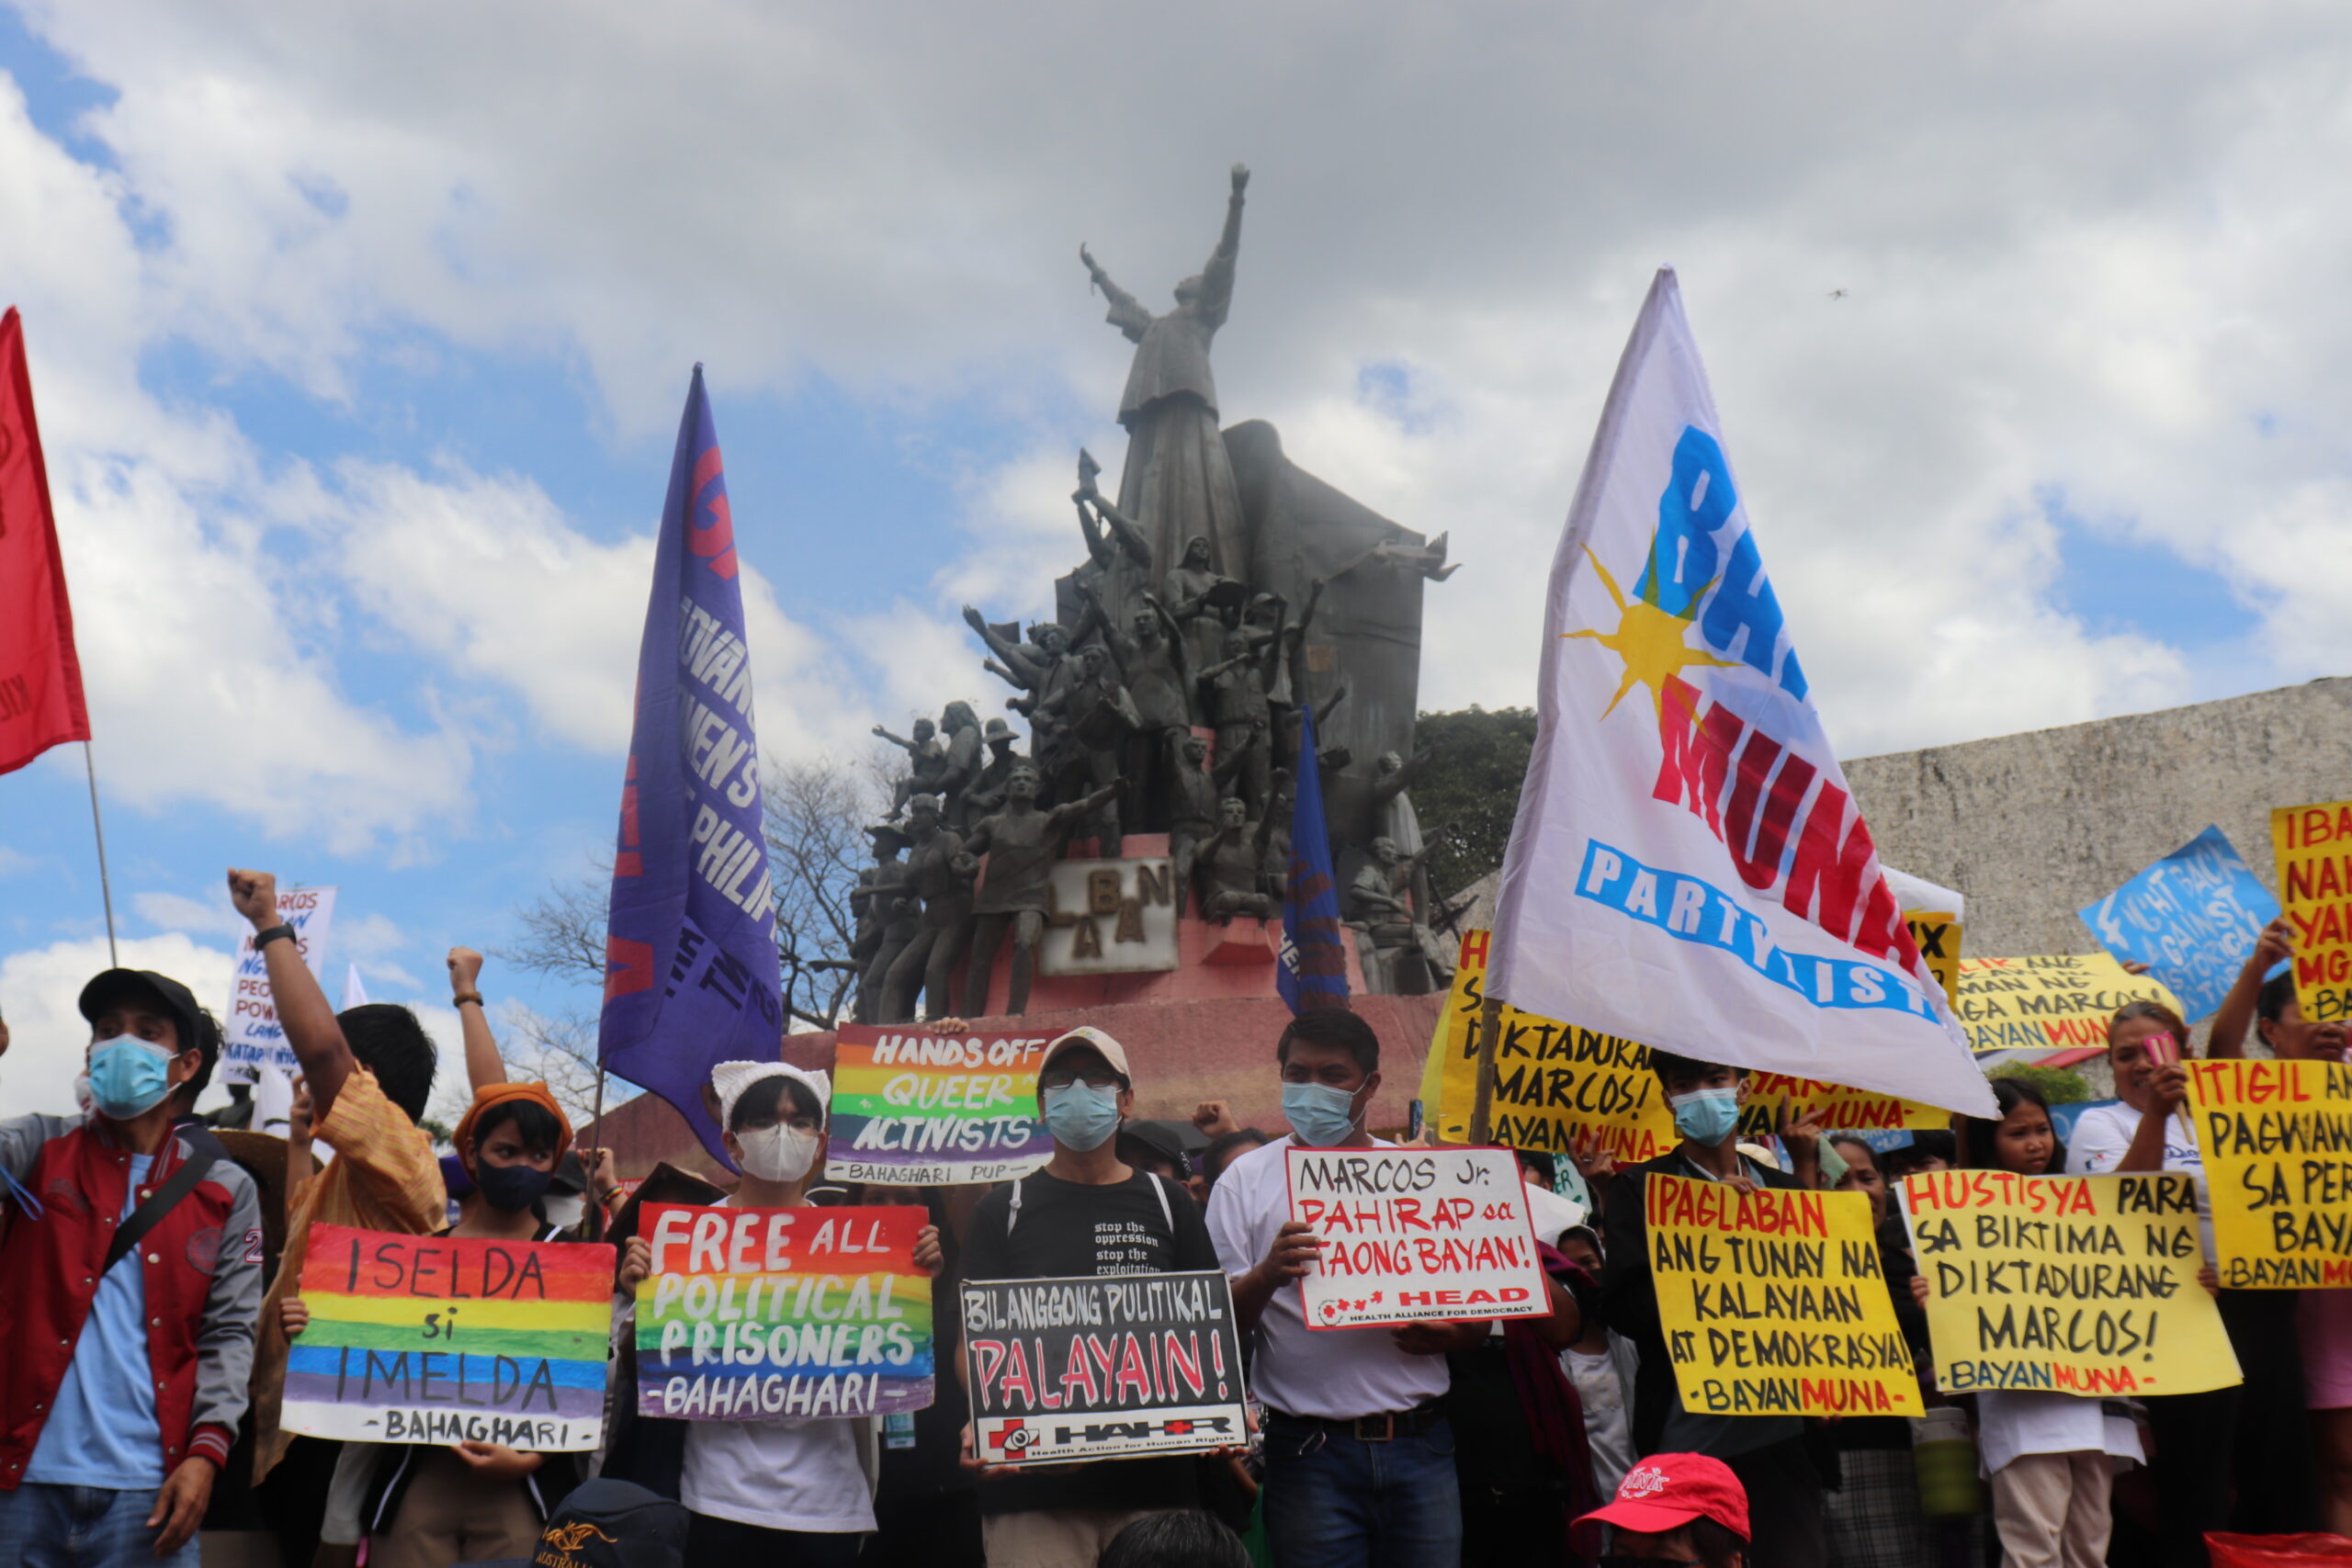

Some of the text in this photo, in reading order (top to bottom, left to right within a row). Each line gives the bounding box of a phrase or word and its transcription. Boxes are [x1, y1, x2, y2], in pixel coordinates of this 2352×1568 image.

[2098, 868, 2184, 950] FIGHT
[2142, 884, 2245, 967] AGAINST
[872, 1034, 1046, 1068] HANDS OFF
[882, 1073, 1014, 1110] QUEER
[2191, 1062, 2312, 1107] ITIGIL
[853, 1113, 1033, 1153] ACTIVISTS
[1300, 1157, 1490, 1195] MARCOS Jr.
[1906, 1171, 2198, 1217] HUSTISYA PARA
[2243, 1161, 2290, 1212] SA
[1298, 1197, 1516, 1235] PAHIRAP sa
[1648, 1173, 1828, 1237] IPAGLABAN
[650, 1210, 890, 1275] FREE ALL
[1094, 1222, 1146, 1234] stop the
[1095, 1234, 1159, 1247] oppression
[1917, 1214, 2195, 1258] SA BIKTIMA NG
[1096, 1247, 1147, 1262] stop the
[1657, 1232, 1882, 1280] ANG TUNAY NA
[653, 1272, 903, 1322] POLITICAL
[1398, 1288, 1530, 1306] HEAD
[1691, 1278, 1864, 1324] KALAYAAN
[1938, 1259, 2180, 1299] DIKTADURANG
[422, 1307, 458, 1340] si
[965, 1280, 1222, 1332] BILANGGONG PULITIKAL
[1351, 1306, 1533, 1322] HEALTH ALLIANCE FOR DEMOCRACY
[661, 1320, 914, 1367] PRISONERS
[1671, 1326, 1915, 1377] AT DEMOKRASYA!
[1977, 1303, 2158, 1362] MARCOS!
[336, 1346, 558, 1411] IMELDA
[970, 1329, 1228, 1411] PALAYAIN!
[1031, 1449, 1075, 1457] Health
[1079, 1445, 1121, 1453] Action
[1147, 1438, 1191, 1447] Human
[1195, 1435, 1236, 1444] Rights
